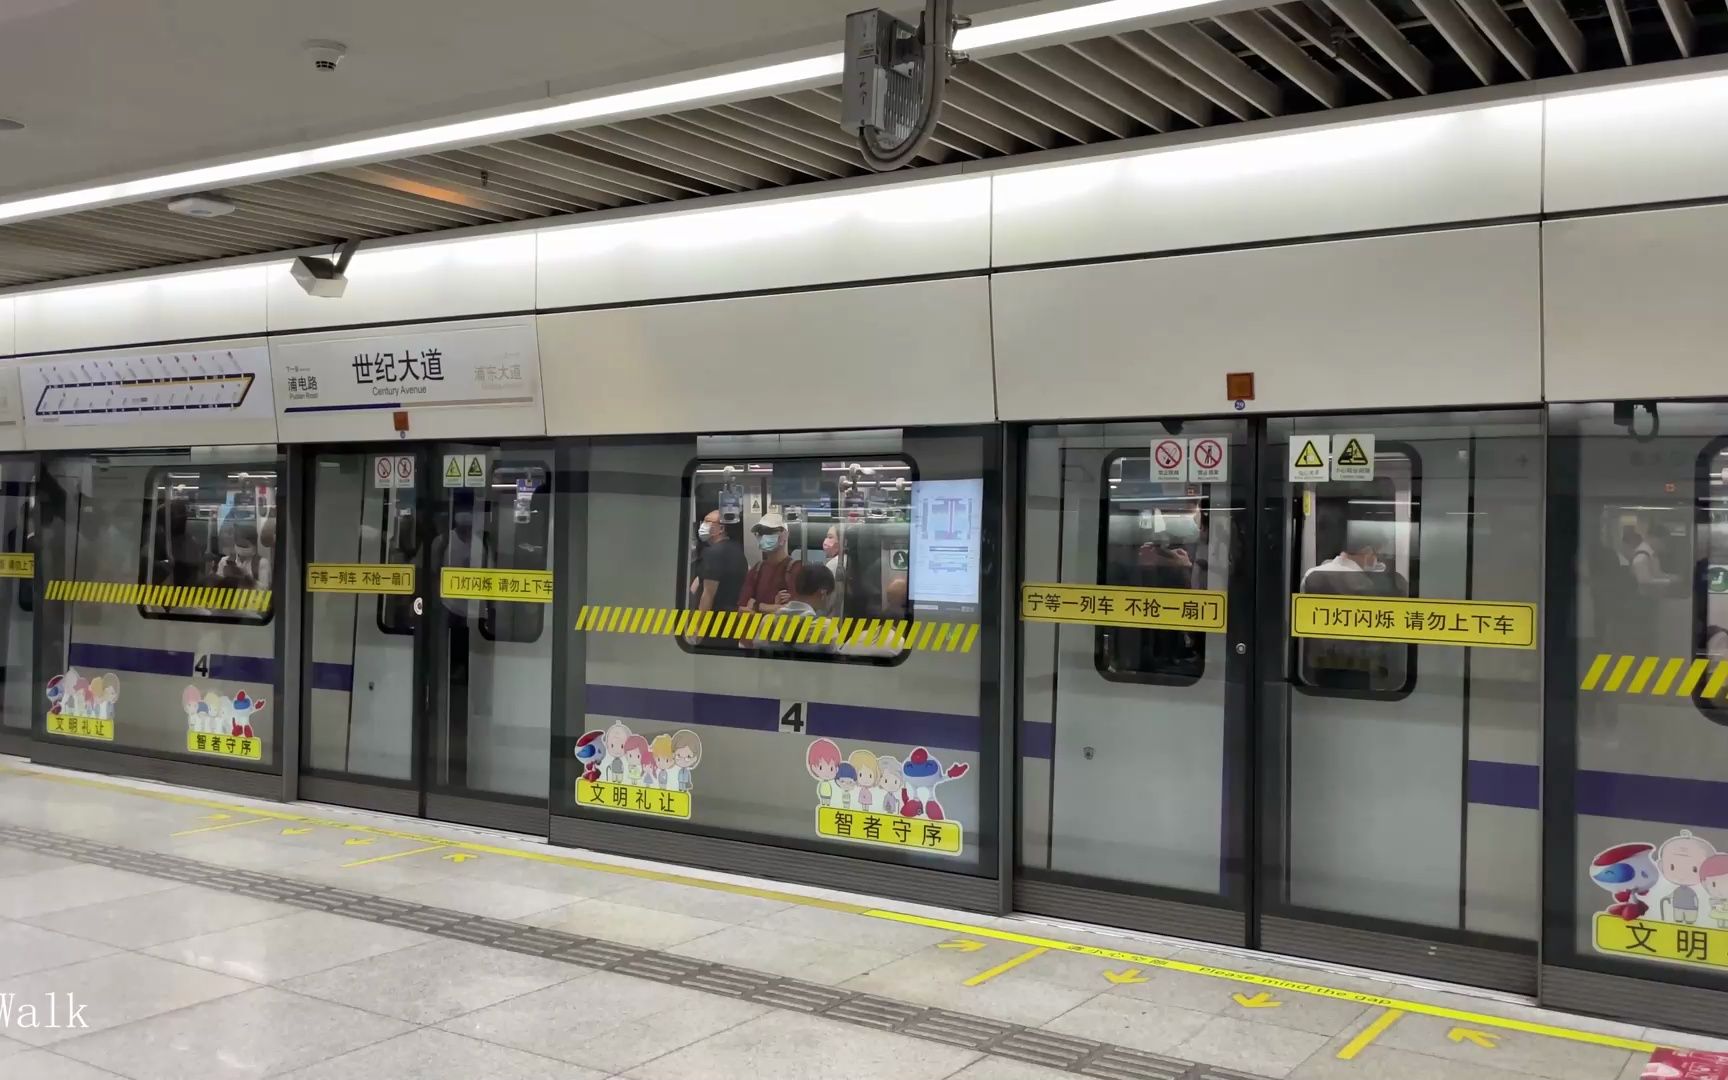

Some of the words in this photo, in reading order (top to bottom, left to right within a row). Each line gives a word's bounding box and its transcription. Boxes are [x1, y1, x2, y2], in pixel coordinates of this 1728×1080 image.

[352, 348, 445, 384] 世纪大道
[288, 375, 318, 392] 浦电路
[372, 386, 399, 396] Century
[400, 385, 427, 394] Avenue
[311, 571, 357, 585] 宁等一列车
[362, 572, 411, 586] 不抢一扇门
[450, 576, 493, 592] 门灯闪烁
[498, 578, 553, 595] 请勿上下车
[1028, 593, 1114, 615] 宁等一列车
[1125, 598, 1218, 620] 不抢一扇门
[1312, 607, 1395, 628] 门灯闪烁
[1404, 610, 1515, 636] 请勿上下车
[194, 654, 208, 677] 4
[56, 717, 105, 736] 文明礼让
[780, 702, 805, 733] 4
[197, 734, 252, 756] 智者守序
[590, 784, 675, 813] 文明礼让
[833, 810, 943, 848] 智者守序
[1625, 922, 1708, 961] 文明
[1199, 966, 1255, 981] Please
[1262, 977, 1309, 991] mind
[1316, 986, 1347, 998] the
[1354, 994, 1392, 1006] gap
